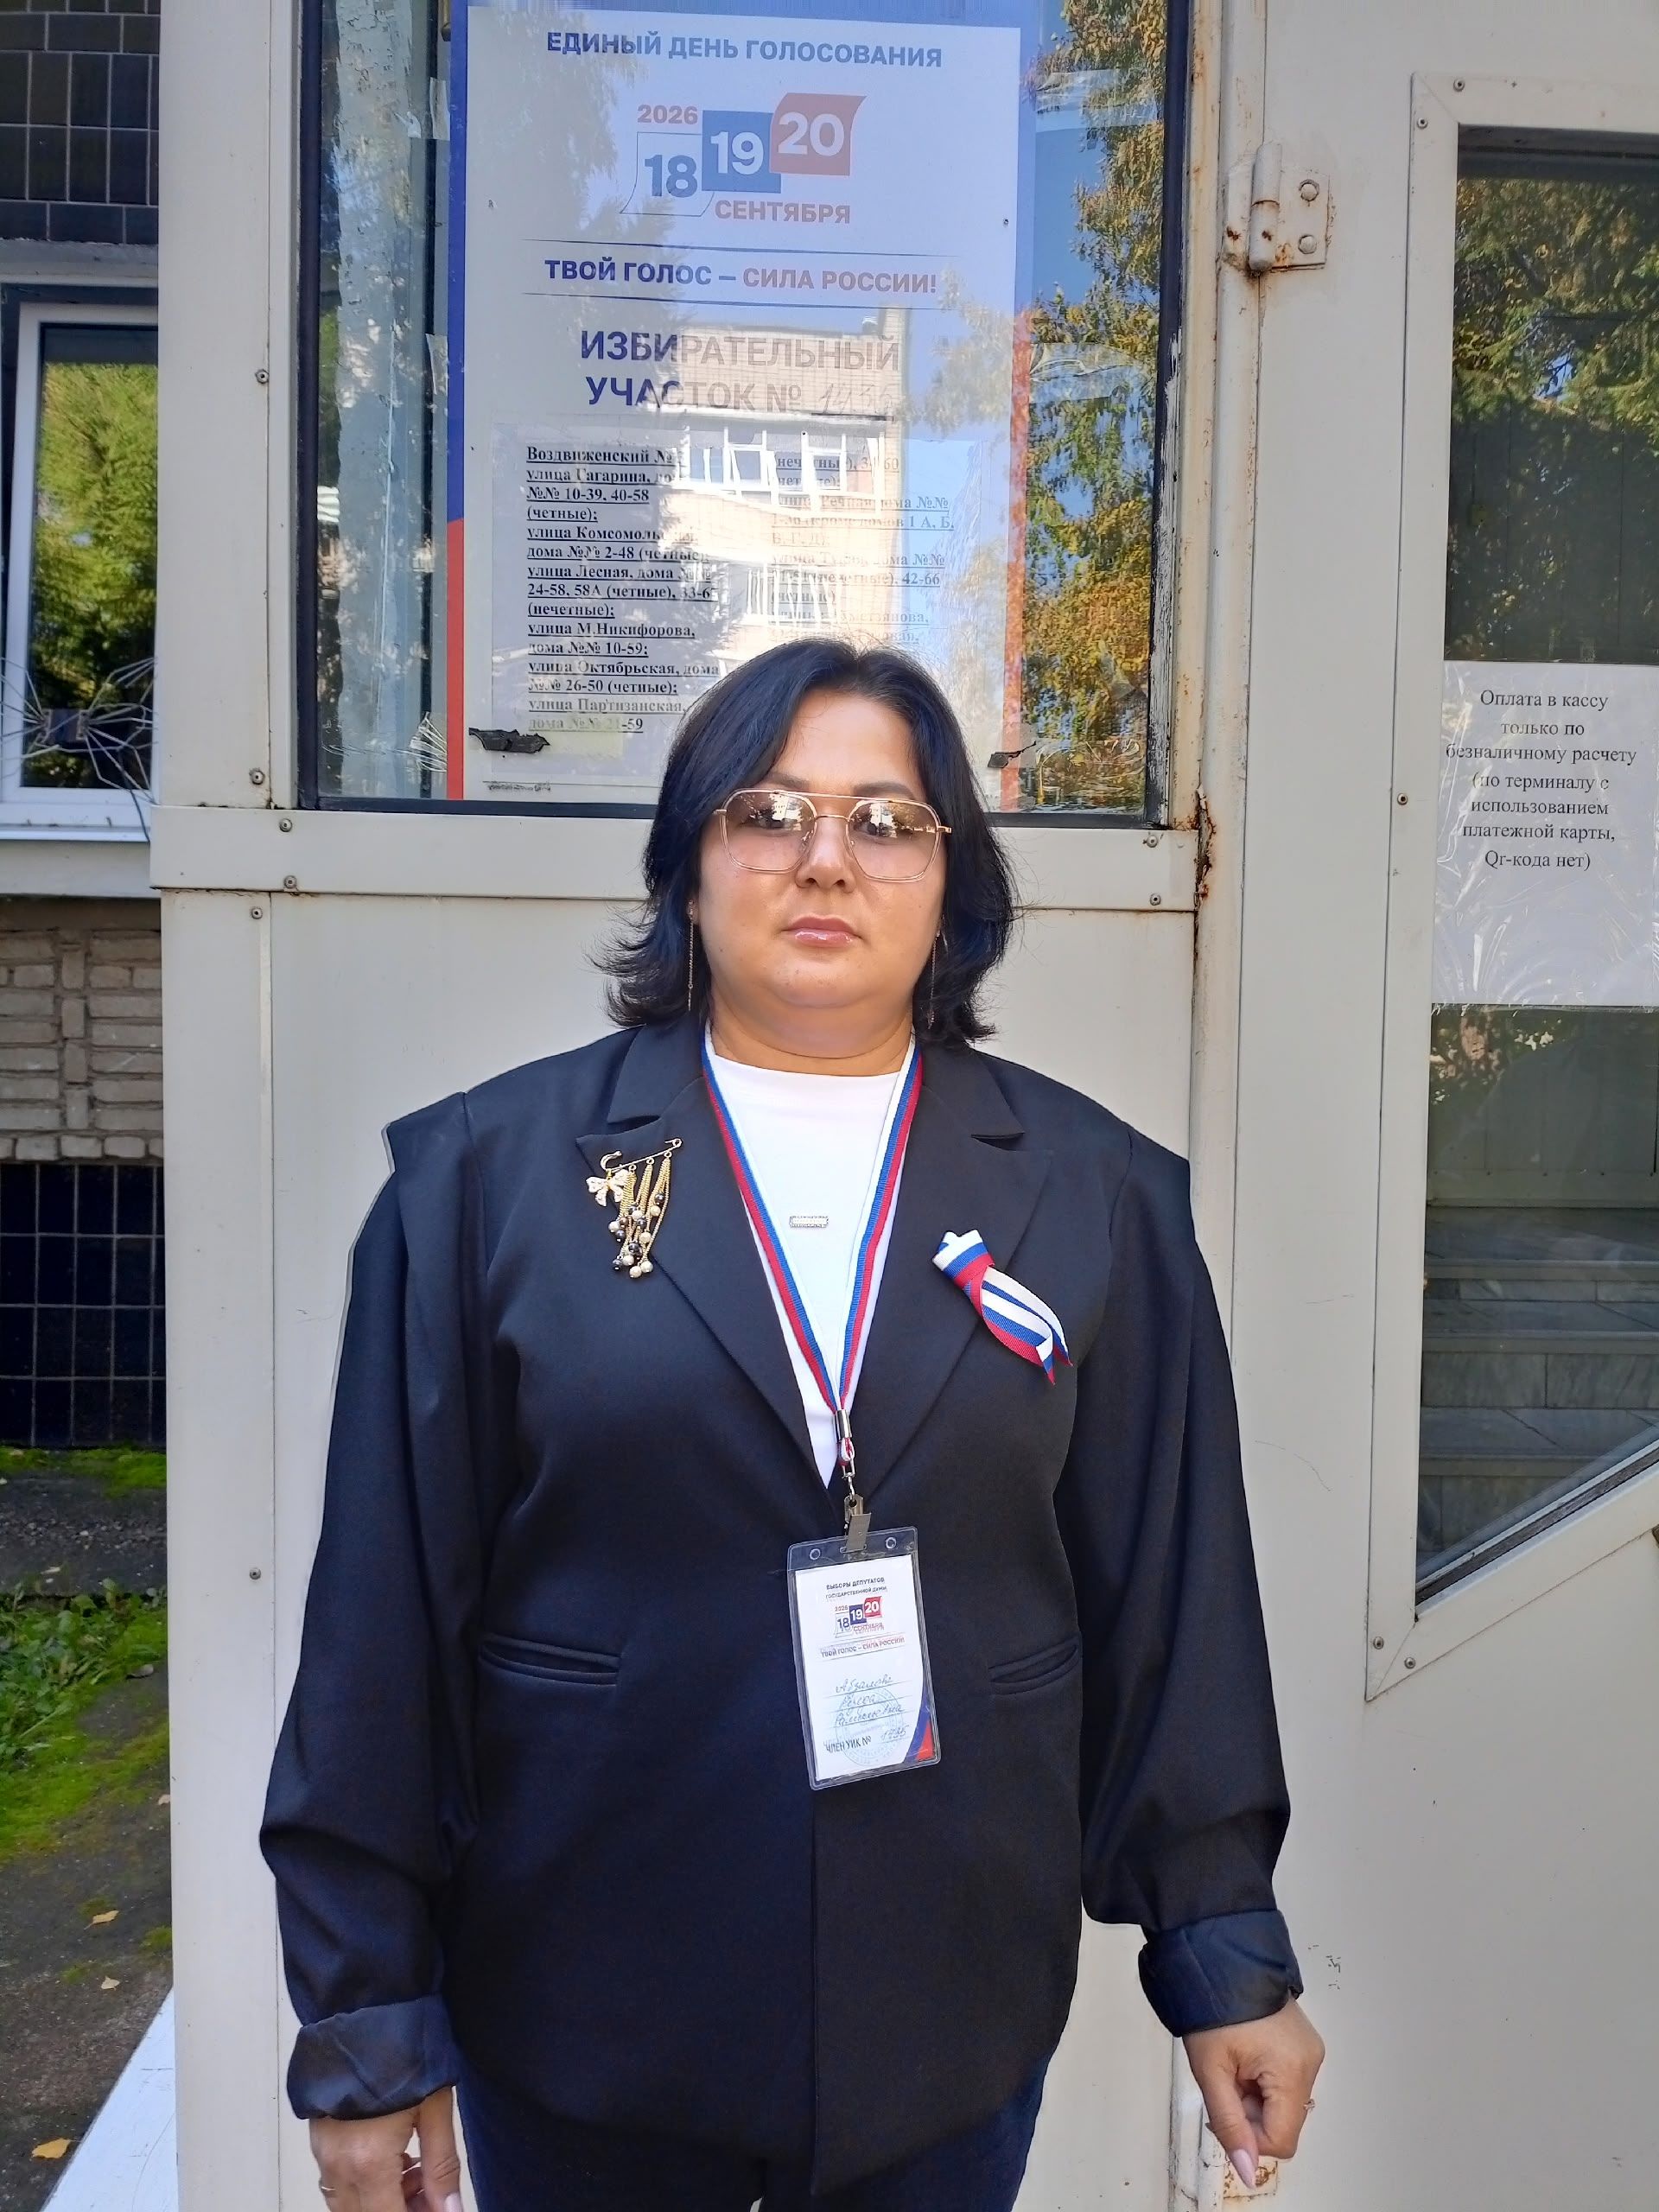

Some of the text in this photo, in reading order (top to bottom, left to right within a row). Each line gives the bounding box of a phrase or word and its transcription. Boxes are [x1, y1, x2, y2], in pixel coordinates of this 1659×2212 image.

[546, 30, 942, 67] ЕДИНЫЙ ДЕНЬ ГОЛОСОВАНИЯ
[637, 104, 698, 124] 2026
[645, 112, 845, 198] 18 19 20
[715, 200, 851, 225] СЕНТЯБРЯ
[544, 257, 619, 282] ТВОЙ
[624, 262, 712, 286] ГОЛОС
[742, 267, 815, 291] СИЛА
[822, 270, 937, 294] РОССИИ!
[582, 330, 899, 371] ИЗБИРАТЕЛЬНЫЙ
[586, 377, 757, 411] УЧАСТОК
[766, 384, 802, 413] №
[526, 446, 649, 463] Воздвиженский
[527, 470, 570, 483] улица
[576, 469, 651, 484] Гагарина,
[527, 486, 560, 499] №№
[611, 488, 649, 502] 40-58
[916, 495, 949, 510] №№
[527, 505, 598, 521] (четные);
[527, 526, 571, 539] улица
[527, 546, 563, 559] дома
[567, 545, 601, 558] №№
[605, 545, 634, 559] 2-48
[912, 553, 945, 566] №№
[527, 566, 571, 578] улица
[575, 564, 633, 579] Лесная,
[637, 567, 673, 580] дома
[901, 573, 940, 585] 42-66
[574, 584, 601, 596] 58А
[607, 585, 676, 599] (четные),
[527, 603, 614, 618] (нечетные);
[528, 622, 695, 638] улица М.Никифорова,
[528, 642, 648, 656] дома №№ 10-59;
[528, 661, 719, 677] улица Октябрьская, дома
[528, 678, 677, 695] №№ 26-50 (четные);
[528, 700, 573, 711] улица
[1480, 690, 1608, 711] Оплата в кассу
[529, 718, 564, 729] дома
[1501, 722, 1585, 735] только по
[1446, 743, 1637, 766] безналичному расчету
[1472, 772, 1610, 793] (по терминалу с
[1471, 800, 1609, 815] использованием
[1463, 823, 1615, 842] платежной карты,
[1484, 850, 1591, 871] Qr-кода нет)
[826, 1577, 885, 1591] ВЫБОРЫ ДЕПУТАТОВ
[836, 1600, 880, 1630] 18 19 20
[823, 1740, 845, 1753] ЧЛЕН
[846, 1738, 861, 1750] УИК
